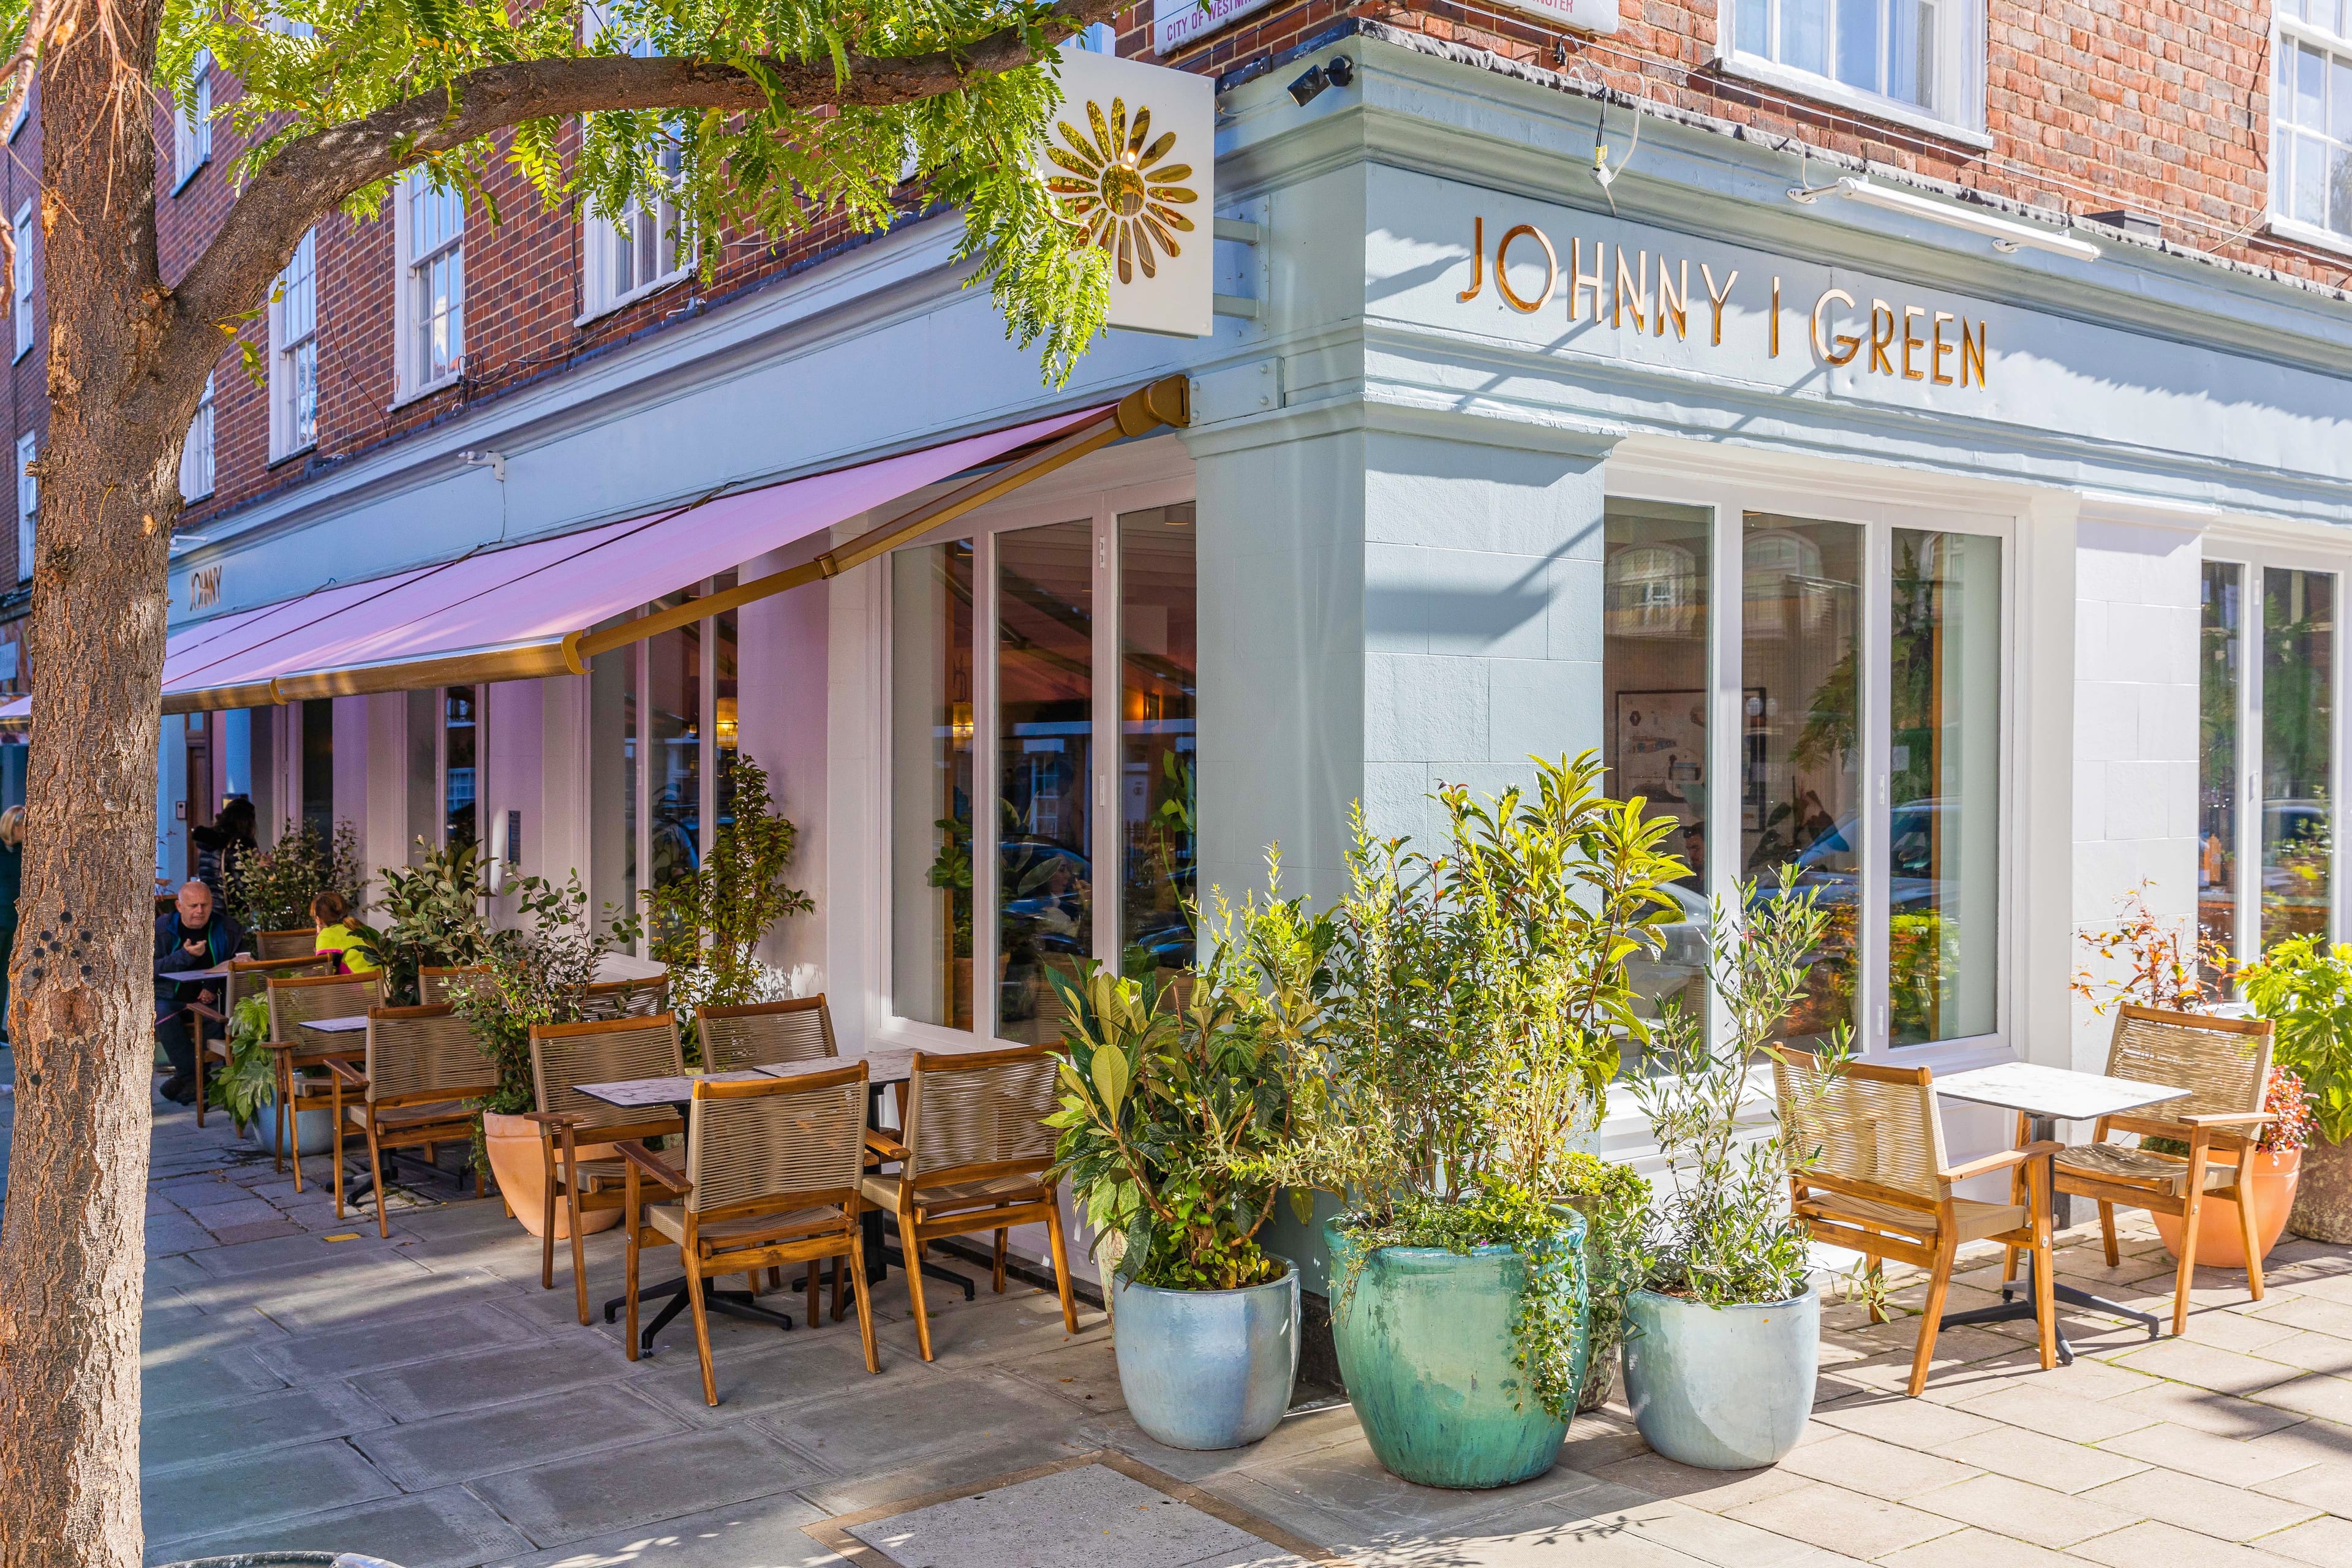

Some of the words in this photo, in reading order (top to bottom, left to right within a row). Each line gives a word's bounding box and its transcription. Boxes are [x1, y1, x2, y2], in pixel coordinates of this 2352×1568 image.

[1167, 17, 1188, 42] CITY
[1192, 9, 1203, 29] OF
[1208, 0, 1251, 21] WEST
[1461, 216, 1738, 345] JOHNNY
[1811, 288, 1986, 391] GREEN
[190, 565, 222, 611] JOHNNY
